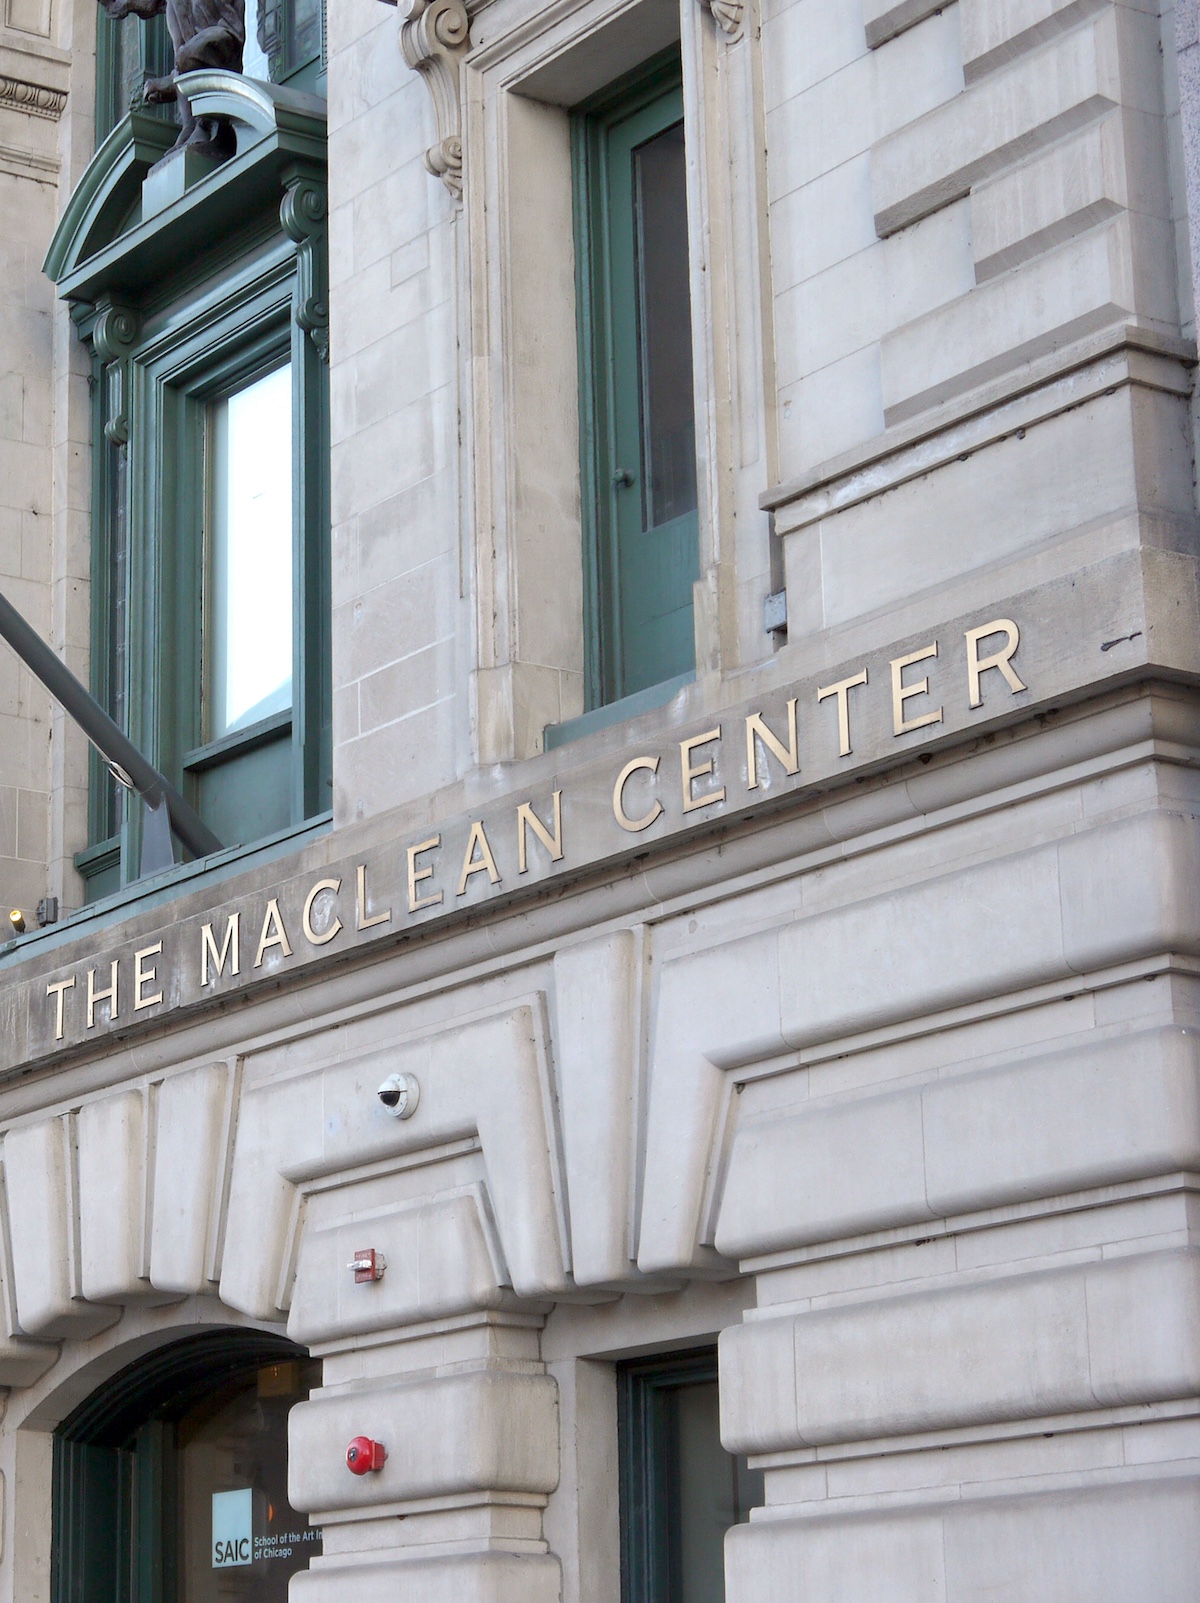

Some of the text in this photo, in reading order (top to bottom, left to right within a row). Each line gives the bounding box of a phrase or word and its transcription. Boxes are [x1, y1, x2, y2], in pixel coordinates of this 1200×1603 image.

[45, 939, 165, 1040] THE
[611, 617, 1029, 833] CENTER
[254, 1533, 279, 1547] School
[279, 1532, 289, 1544] of
[288, 1532, 301, 1544] the
[302, 1530, 314, 1541] Art
[215, 1538, 250, 1564] SAIC
[254, 1546, 293, 1560] of Chicago
